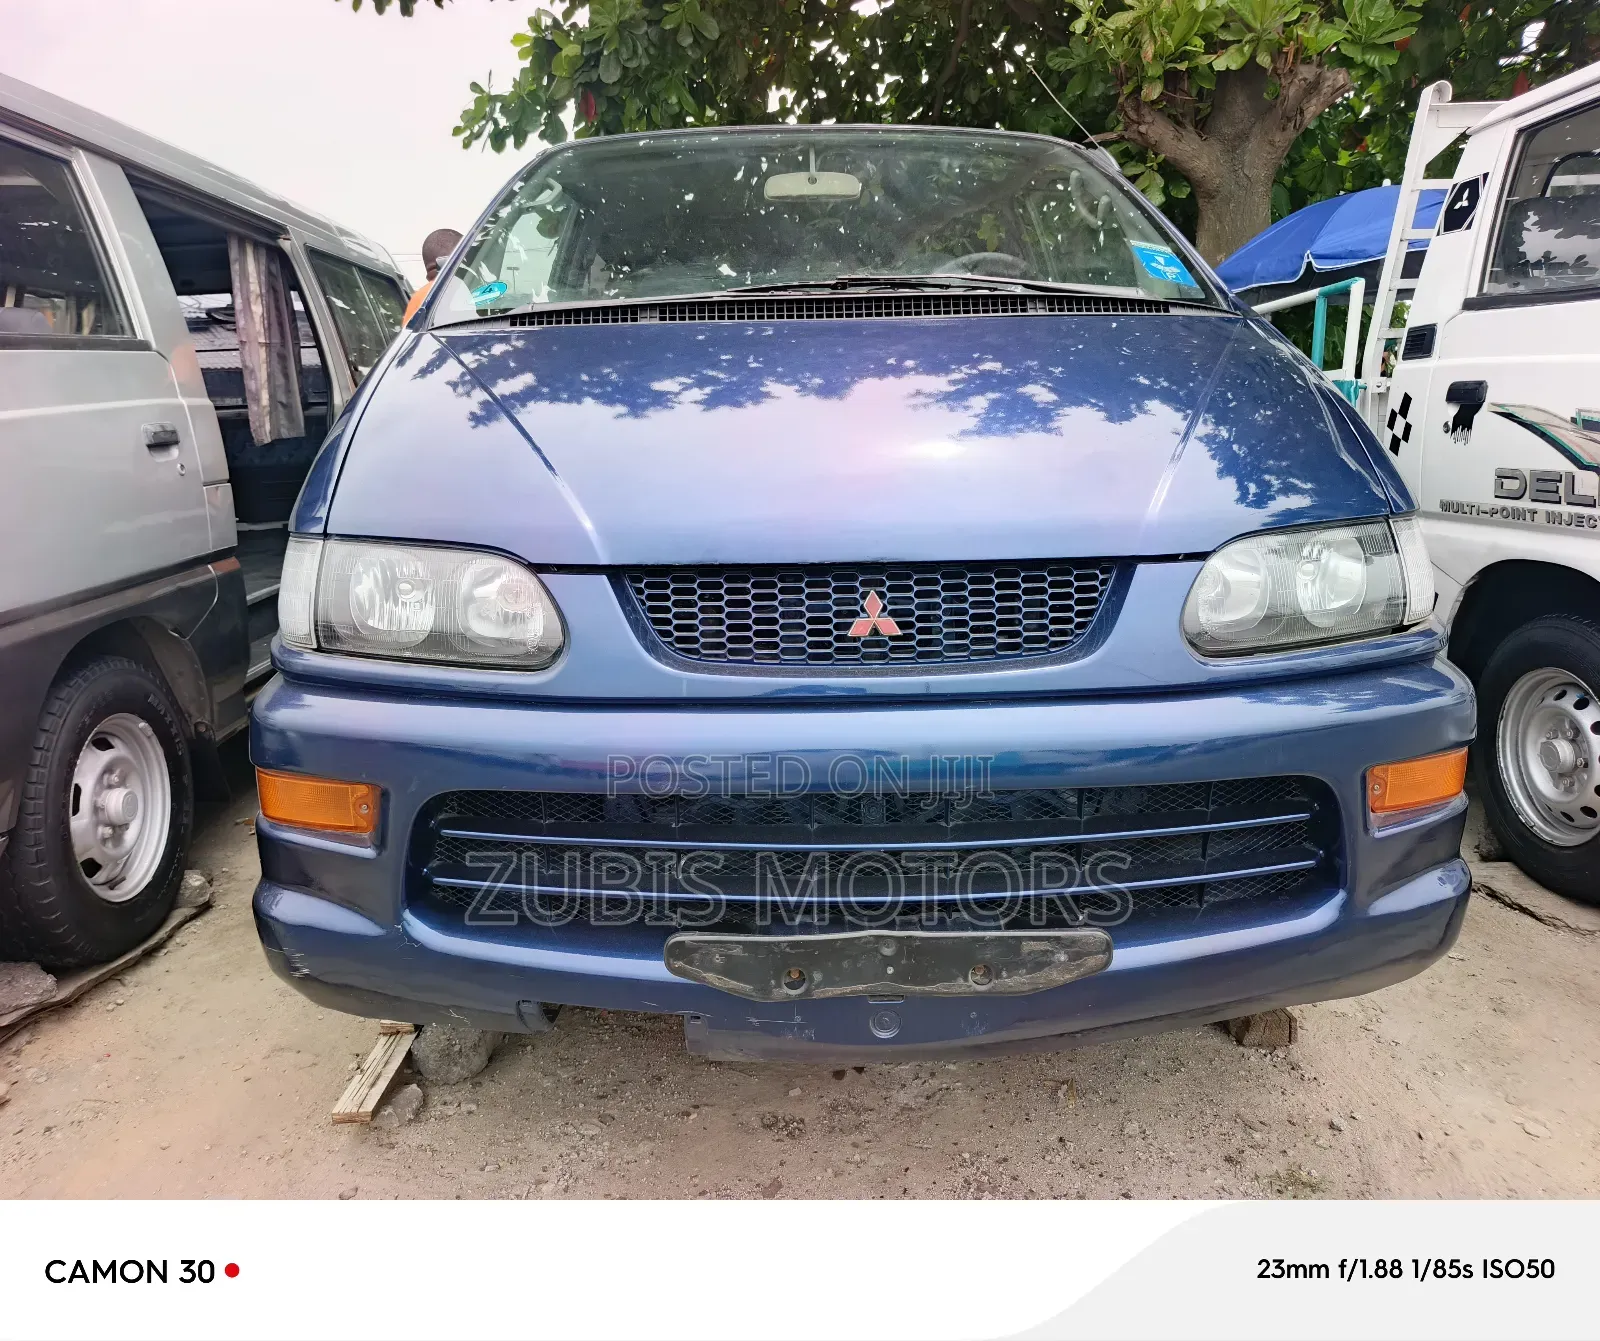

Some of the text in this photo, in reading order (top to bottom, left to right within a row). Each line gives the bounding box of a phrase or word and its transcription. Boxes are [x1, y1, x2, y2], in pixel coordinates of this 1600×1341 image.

[1494, 467, 1600, 509] DEL
[1439, 499, 1600, 529] MULTI-POINT INJEC
